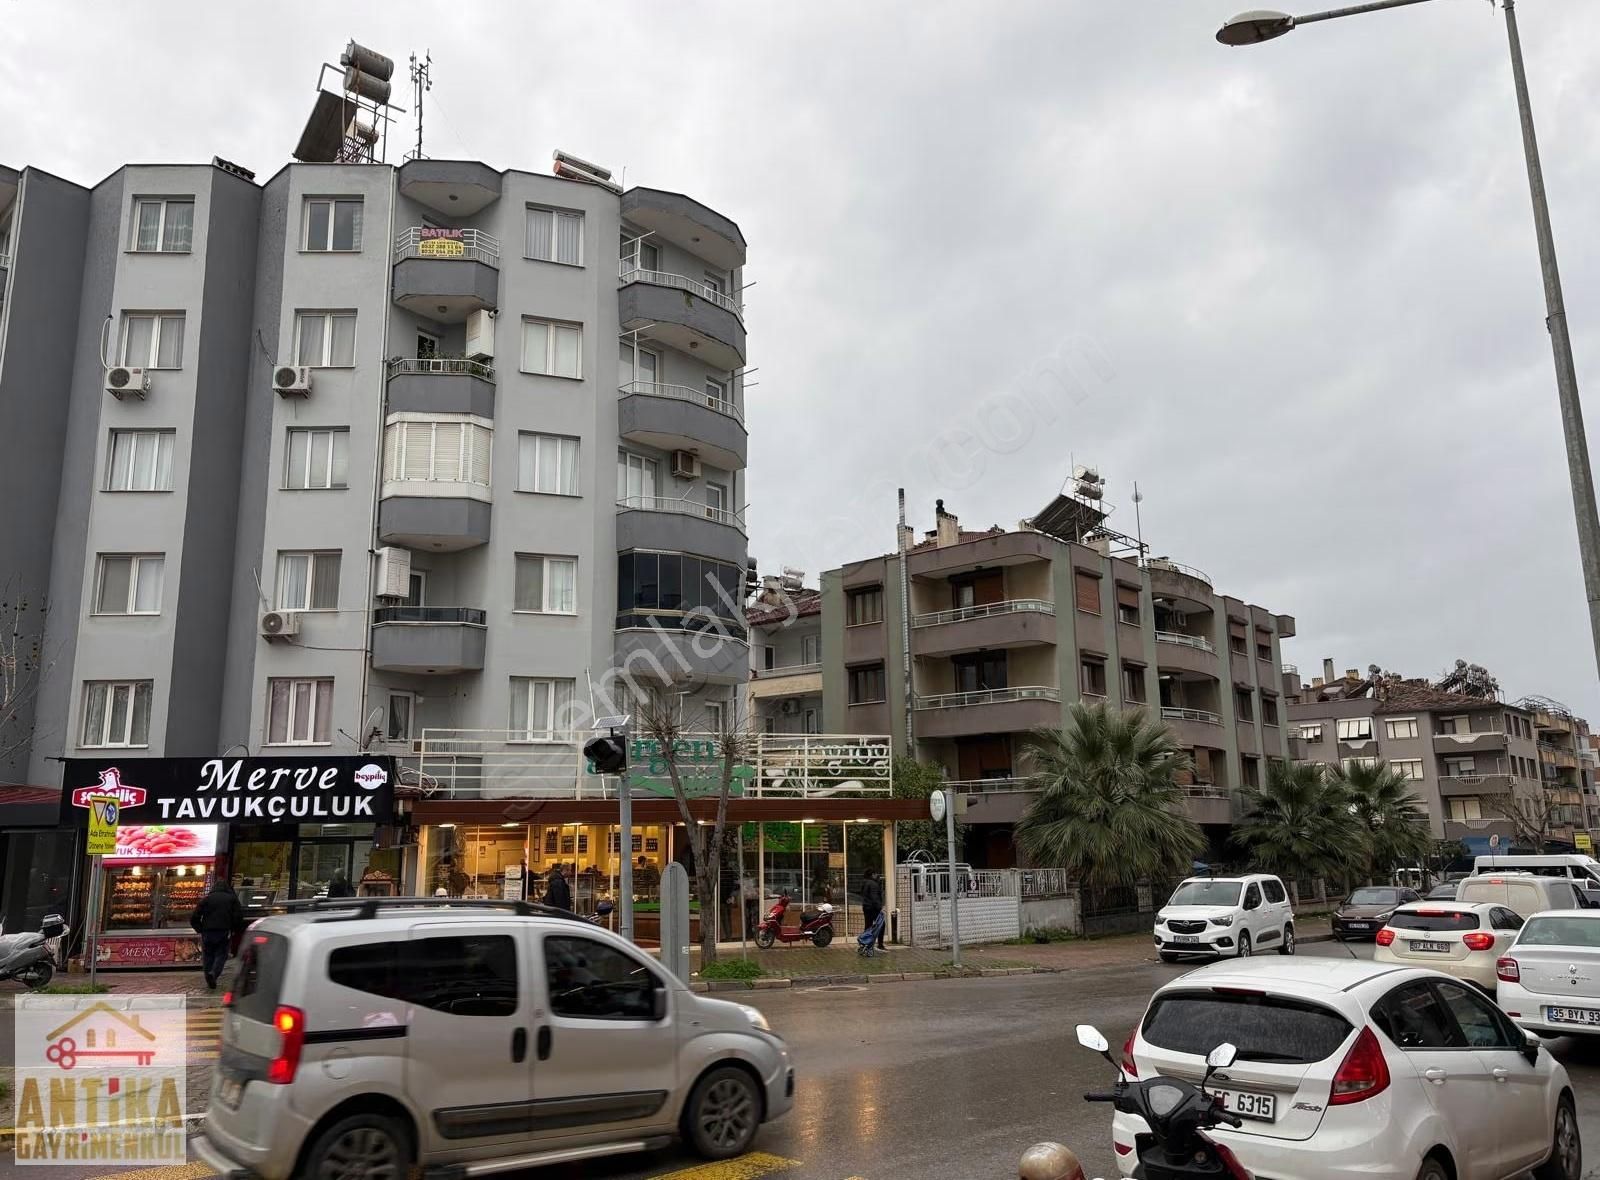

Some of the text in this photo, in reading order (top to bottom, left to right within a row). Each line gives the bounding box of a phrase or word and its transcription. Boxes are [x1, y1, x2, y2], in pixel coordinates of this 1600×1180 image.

[196, 759, 338, 791] Merve
[157, 795, 374, 823] TAVUKÇULUK
[122, 946, 166, 957] MERVE
[1553, 1008, 1564, 1018] 35
[1568, 1009, 1585, 1020] BYA
[1237, 1093, 1272, 1115] 6315
